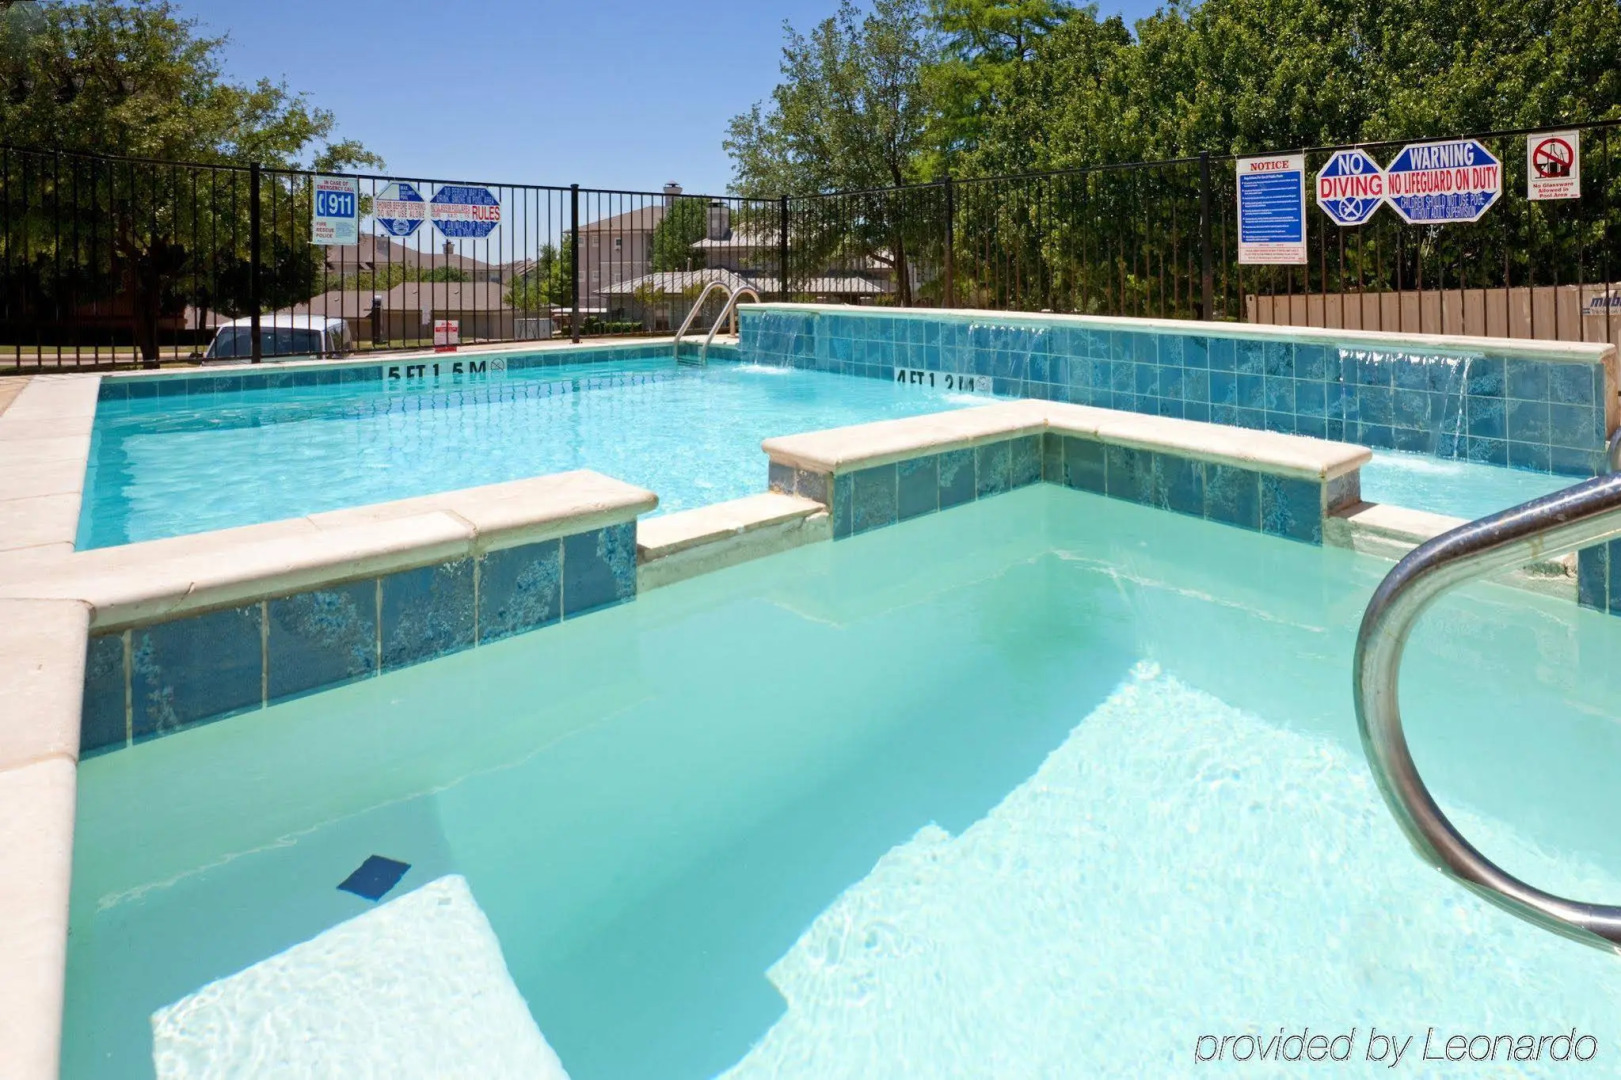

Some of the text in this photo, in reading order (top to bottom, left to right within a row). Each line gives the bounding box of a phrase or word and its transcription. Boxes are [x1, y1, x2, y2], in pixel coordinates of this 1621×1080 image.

[1250, 160, 1289, 171] NOTICE
[1338, 154, 1364, 175] NO
[1409, 143, 1474, 170] WARNING
[1320, 174, 1382, 198] DIVING
[1388, 166, 1498, 194] NO LIFEGUARD ON DUTY
[328, 194, 352, 214] 911
[1400, 196, 1424, 208] CHILDREN
[1426, 195, 1446, 208] SHOULD
[1447, 194, 1458, 206] NOT
[1460, 194, 1468, 206] USE
[472, 206, 500, 220] RULES
[1410, 205, 1476, 219] WITHOUT ADULT SUPERVISION
[388, 366, 401, 379] 5
[406, 364, 426, 379] FT
[470, 360, 486, 374] M
[910, 370, 924, 384] FT
